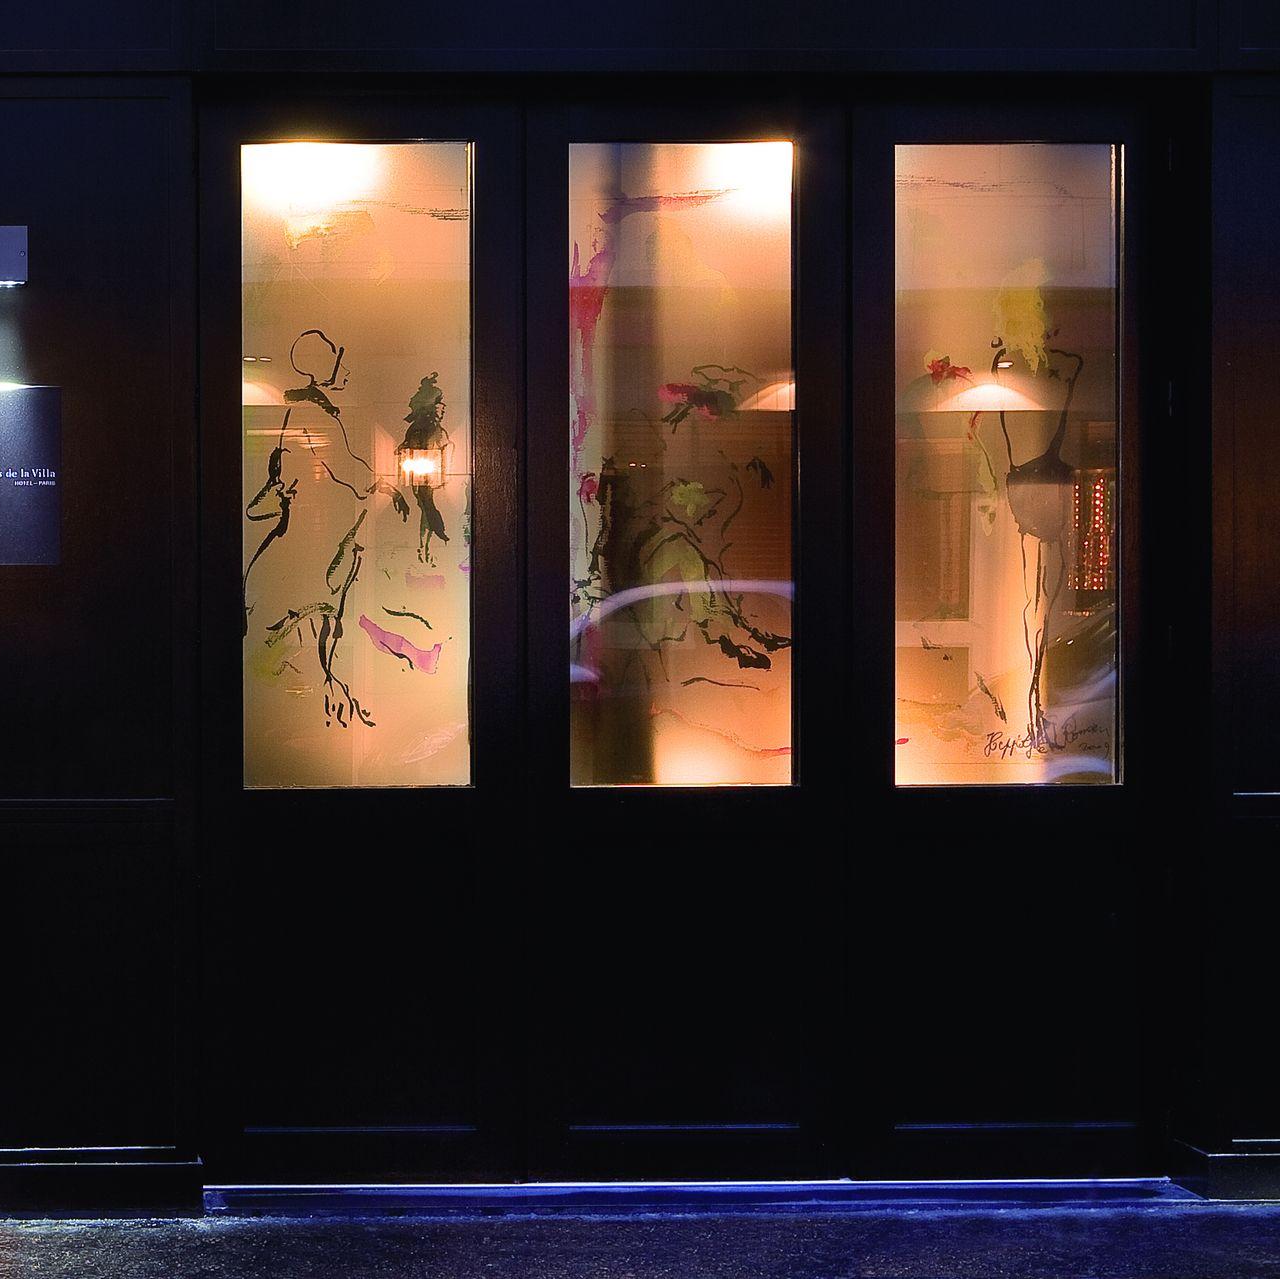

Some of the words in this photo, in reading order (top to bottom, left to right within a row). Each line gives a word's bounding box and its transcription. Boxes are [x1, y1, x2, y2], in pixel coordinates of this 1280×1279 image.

[5, 468, 18, 478] de
[20, 468, 30, 478] la
[31, 468, 56, 478] Villa
